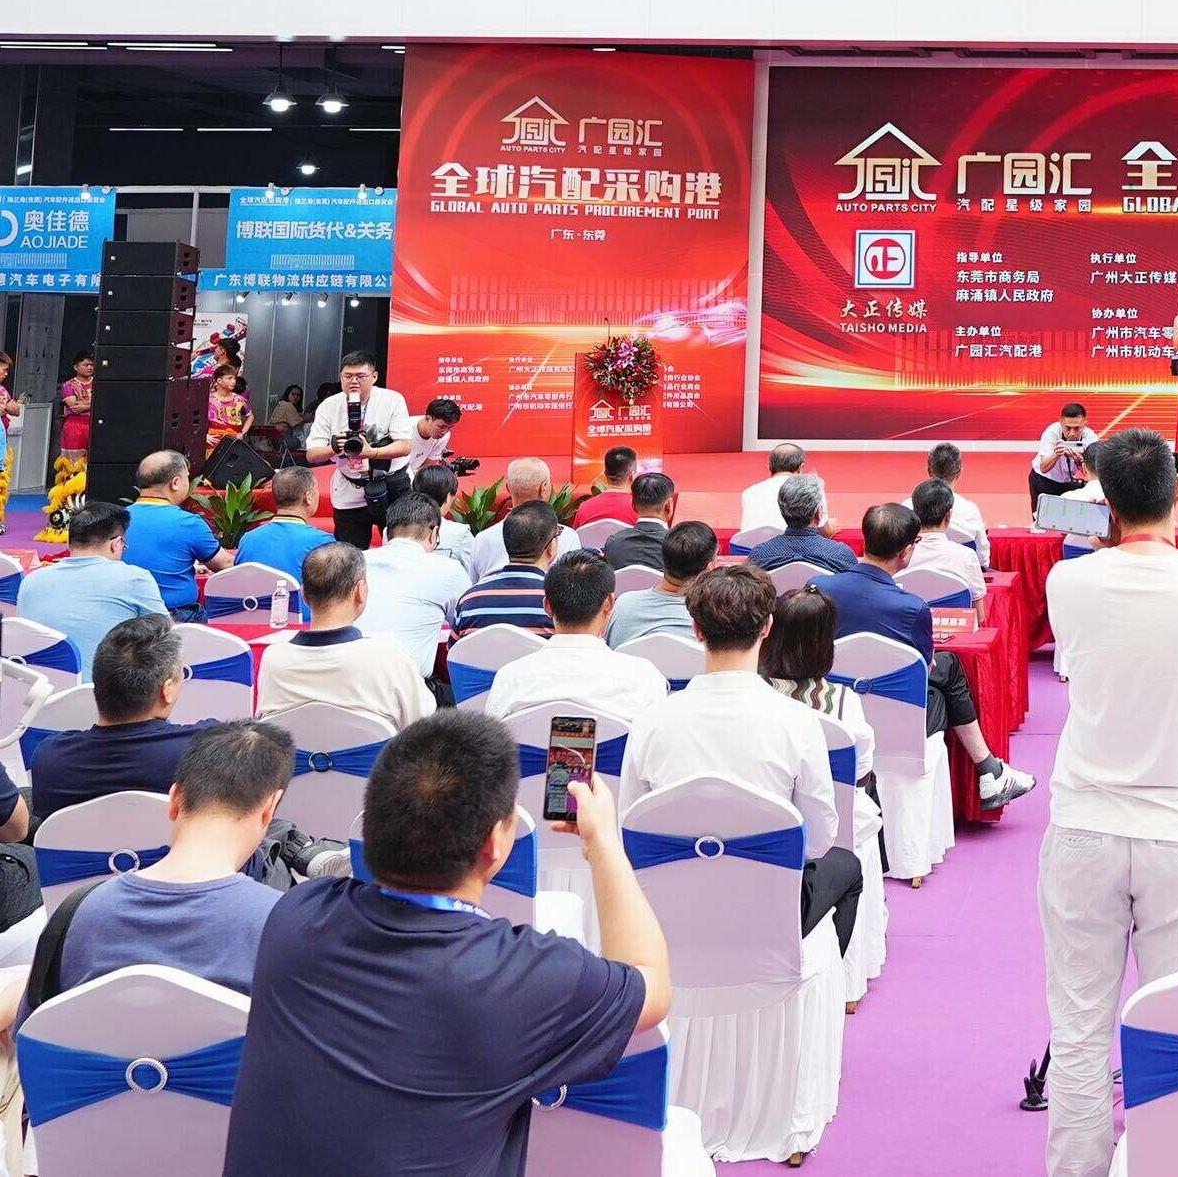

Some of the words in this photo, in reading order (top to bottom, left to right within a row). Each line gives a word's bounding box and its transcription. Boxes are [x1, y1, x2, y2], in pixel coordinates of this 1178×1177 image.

[578, 117, 663, 146] 广园汇
[957, 152, 1092, 195] 广园汇
[430, 161, 722, 206] 全球汽配采购港
[431, 201, 484, 213] GLOBAL
[491, 203, 527, 214] AUTO
[534, 204, 578, 215] PARTS
[585, 206, 681, 219] PROCUREMENT
[687, 208, 720, 219] PORT
[836, 203, 868, 213] AUTO
[871, 203, 907, 213] PARTS
[911, 203, 937, 213] CITY
[957, 198, 1092, 212] 汽配星级家园
[23, 210, 90, 232] 奥佳德
[236, 221, 393, 240] 博联国际货代&关务
[20, 236, 88, 249] AOJIADE
[955, 252, 1003, 263] 指导单位
[1090, 253, 1137, 264] 执行单位
[214, 274, 392, 288] 广东博联物流供应链有限公
[956, 271, 1040, 284] 东莞市商务局
[955, 289, 1054, 303] 麻涌镇人民政府
[840, 297, 928, 319] 大正传媒
[1091, 308, 1138, 319] 协办单位
[840, 323, 887, 333] TAISHO
[888, 323, 927, 333] MEDIA
[955, 326, 1001, 337] 主办单位
[954, 344, 1043, 358] 广园汇汽配港
